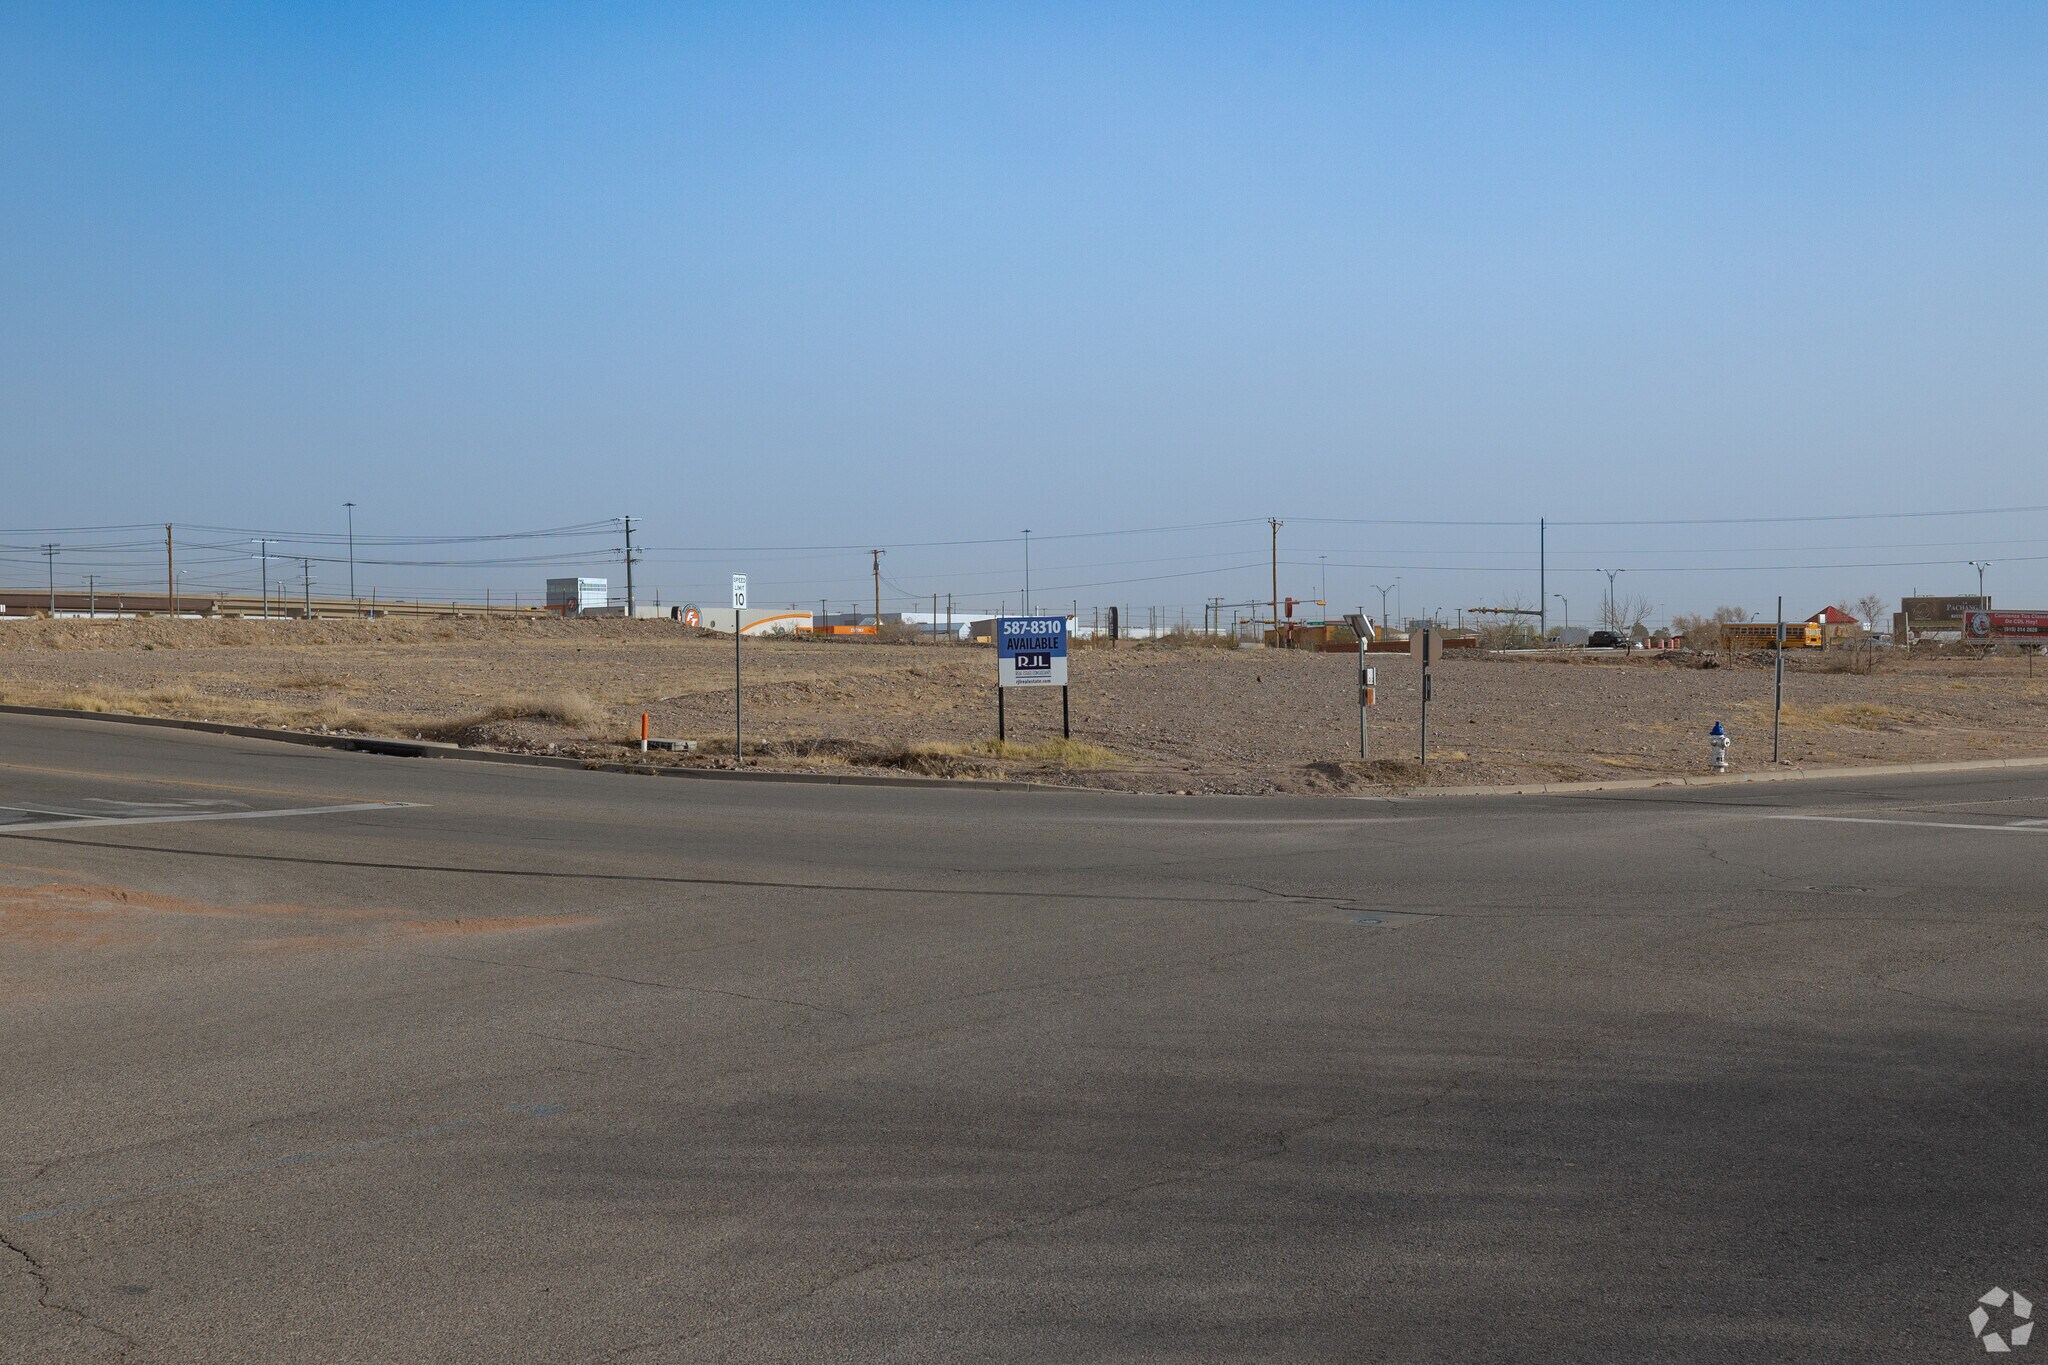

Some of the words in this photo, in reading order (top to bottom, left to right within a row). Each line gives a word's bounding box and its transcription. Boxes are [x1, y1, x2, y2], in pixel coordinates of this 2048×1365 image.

[735, 593, 744, 605] 10
[1003, 620, 1061, 634] 587-8310
[1007, 637, 1059, 650] AVAILABLE
[1018, 655, 1049, 667] RJL
